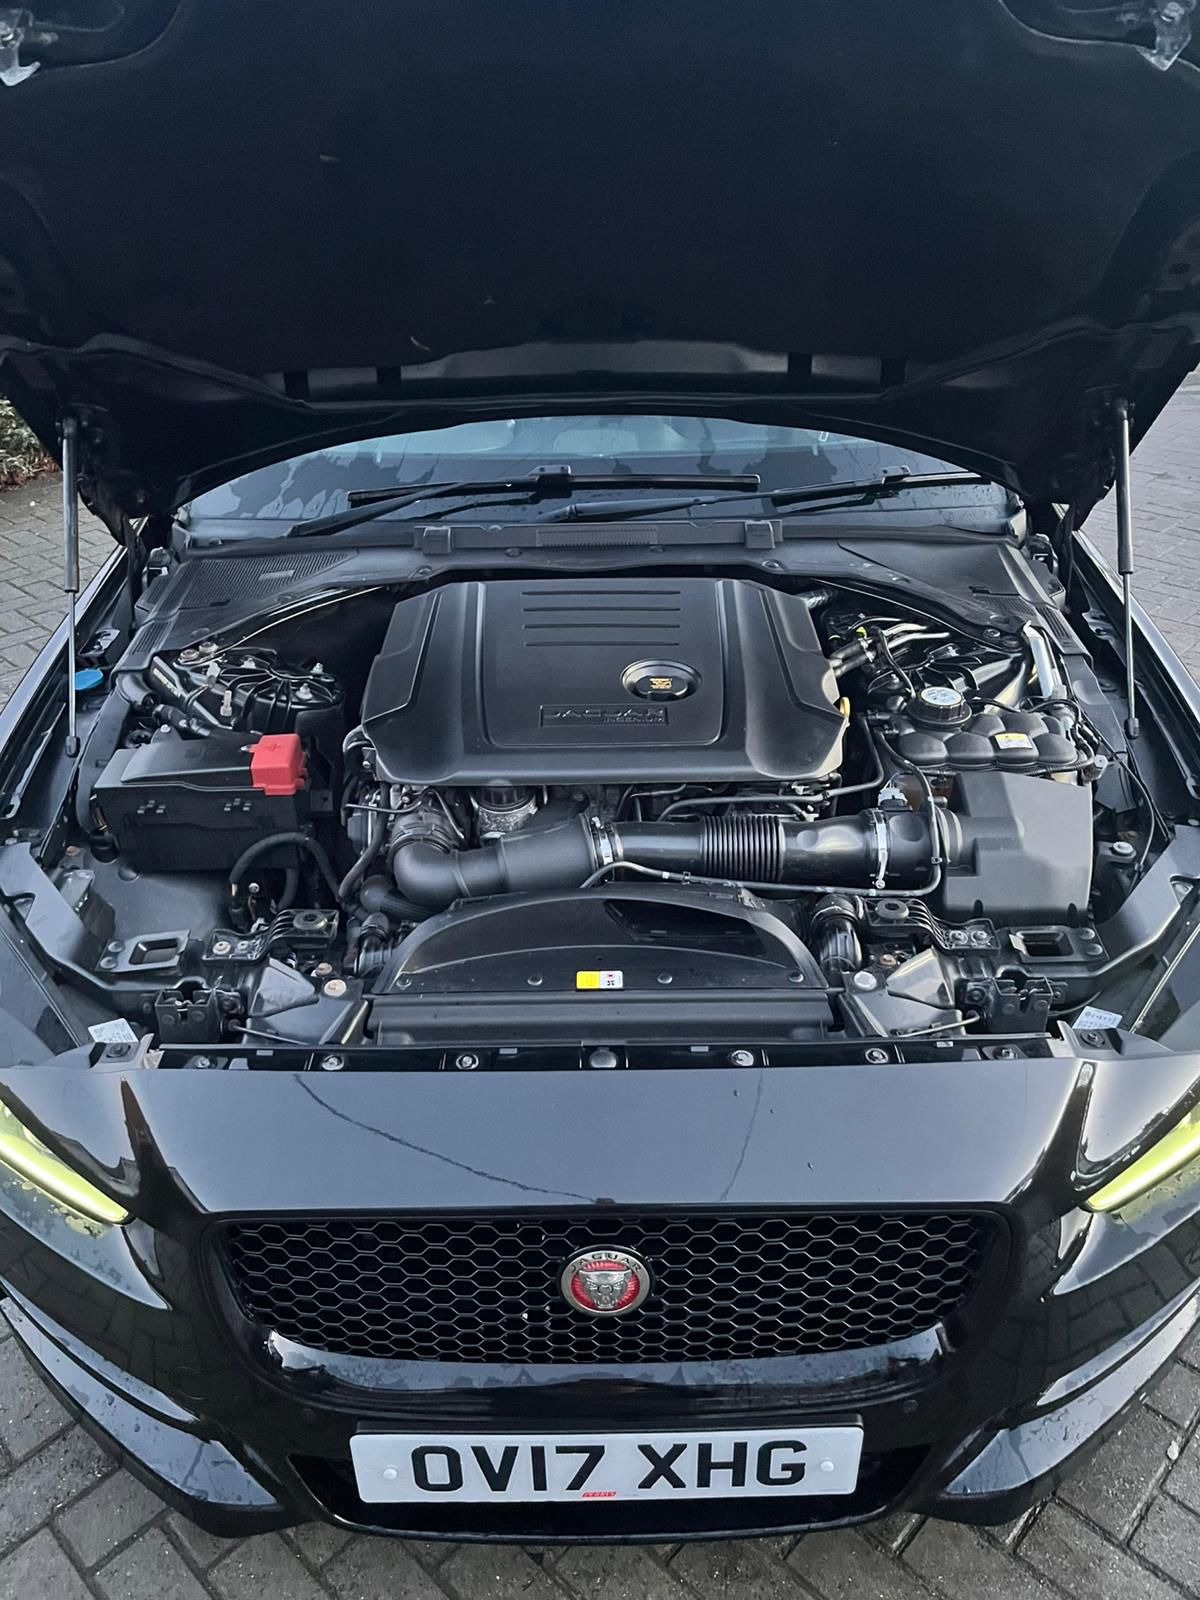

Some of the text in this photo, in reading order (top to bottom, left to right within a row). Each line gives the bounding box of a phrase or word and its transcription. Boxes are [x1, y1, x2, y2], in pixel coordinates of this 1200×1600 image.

[569, 1252, 642, 1273] JAGUAR
[411, 1440, 808, 1492] OV17 XHG
